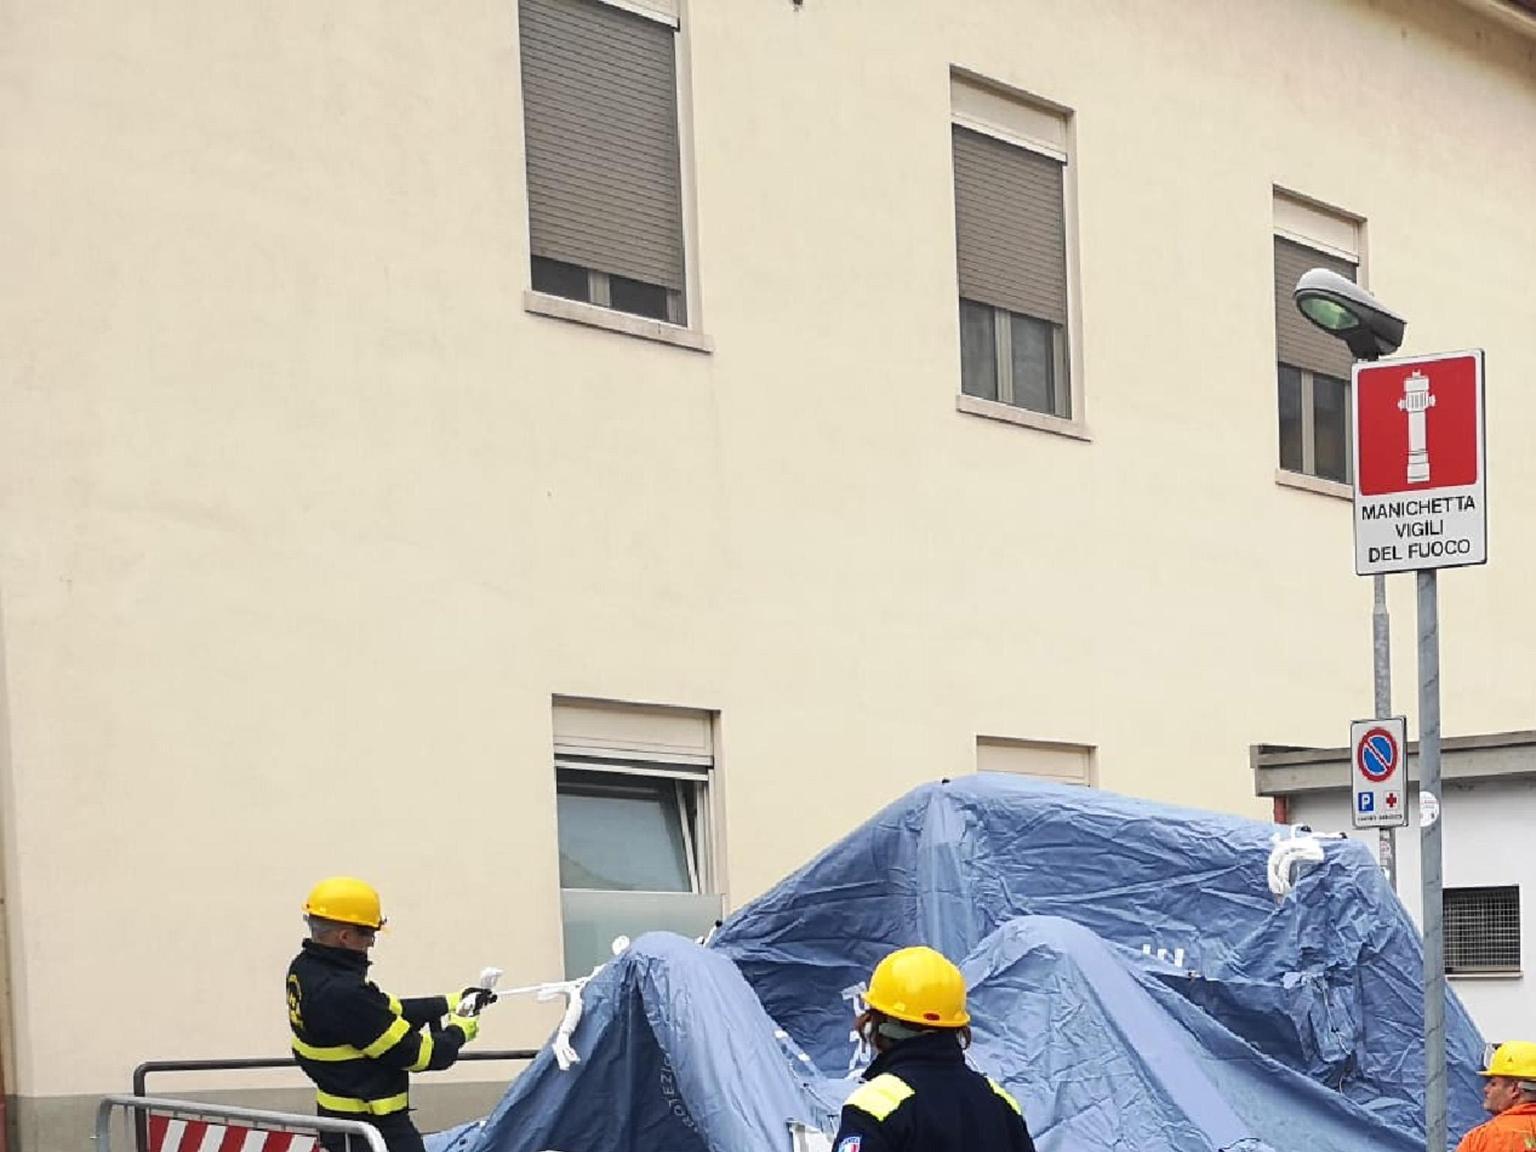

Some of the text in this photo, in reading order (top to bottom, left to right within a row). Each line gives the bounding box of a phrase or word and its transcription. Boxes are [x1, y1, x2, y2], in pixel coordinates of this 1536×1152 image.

[1362, 495, 1475, 521] MANICHETTA
[1395, 519, 1444, 538] VIGILI
[1368, 539, 1471, 563] DEL FUOCO
[1361, 793, 1371, 810] P
